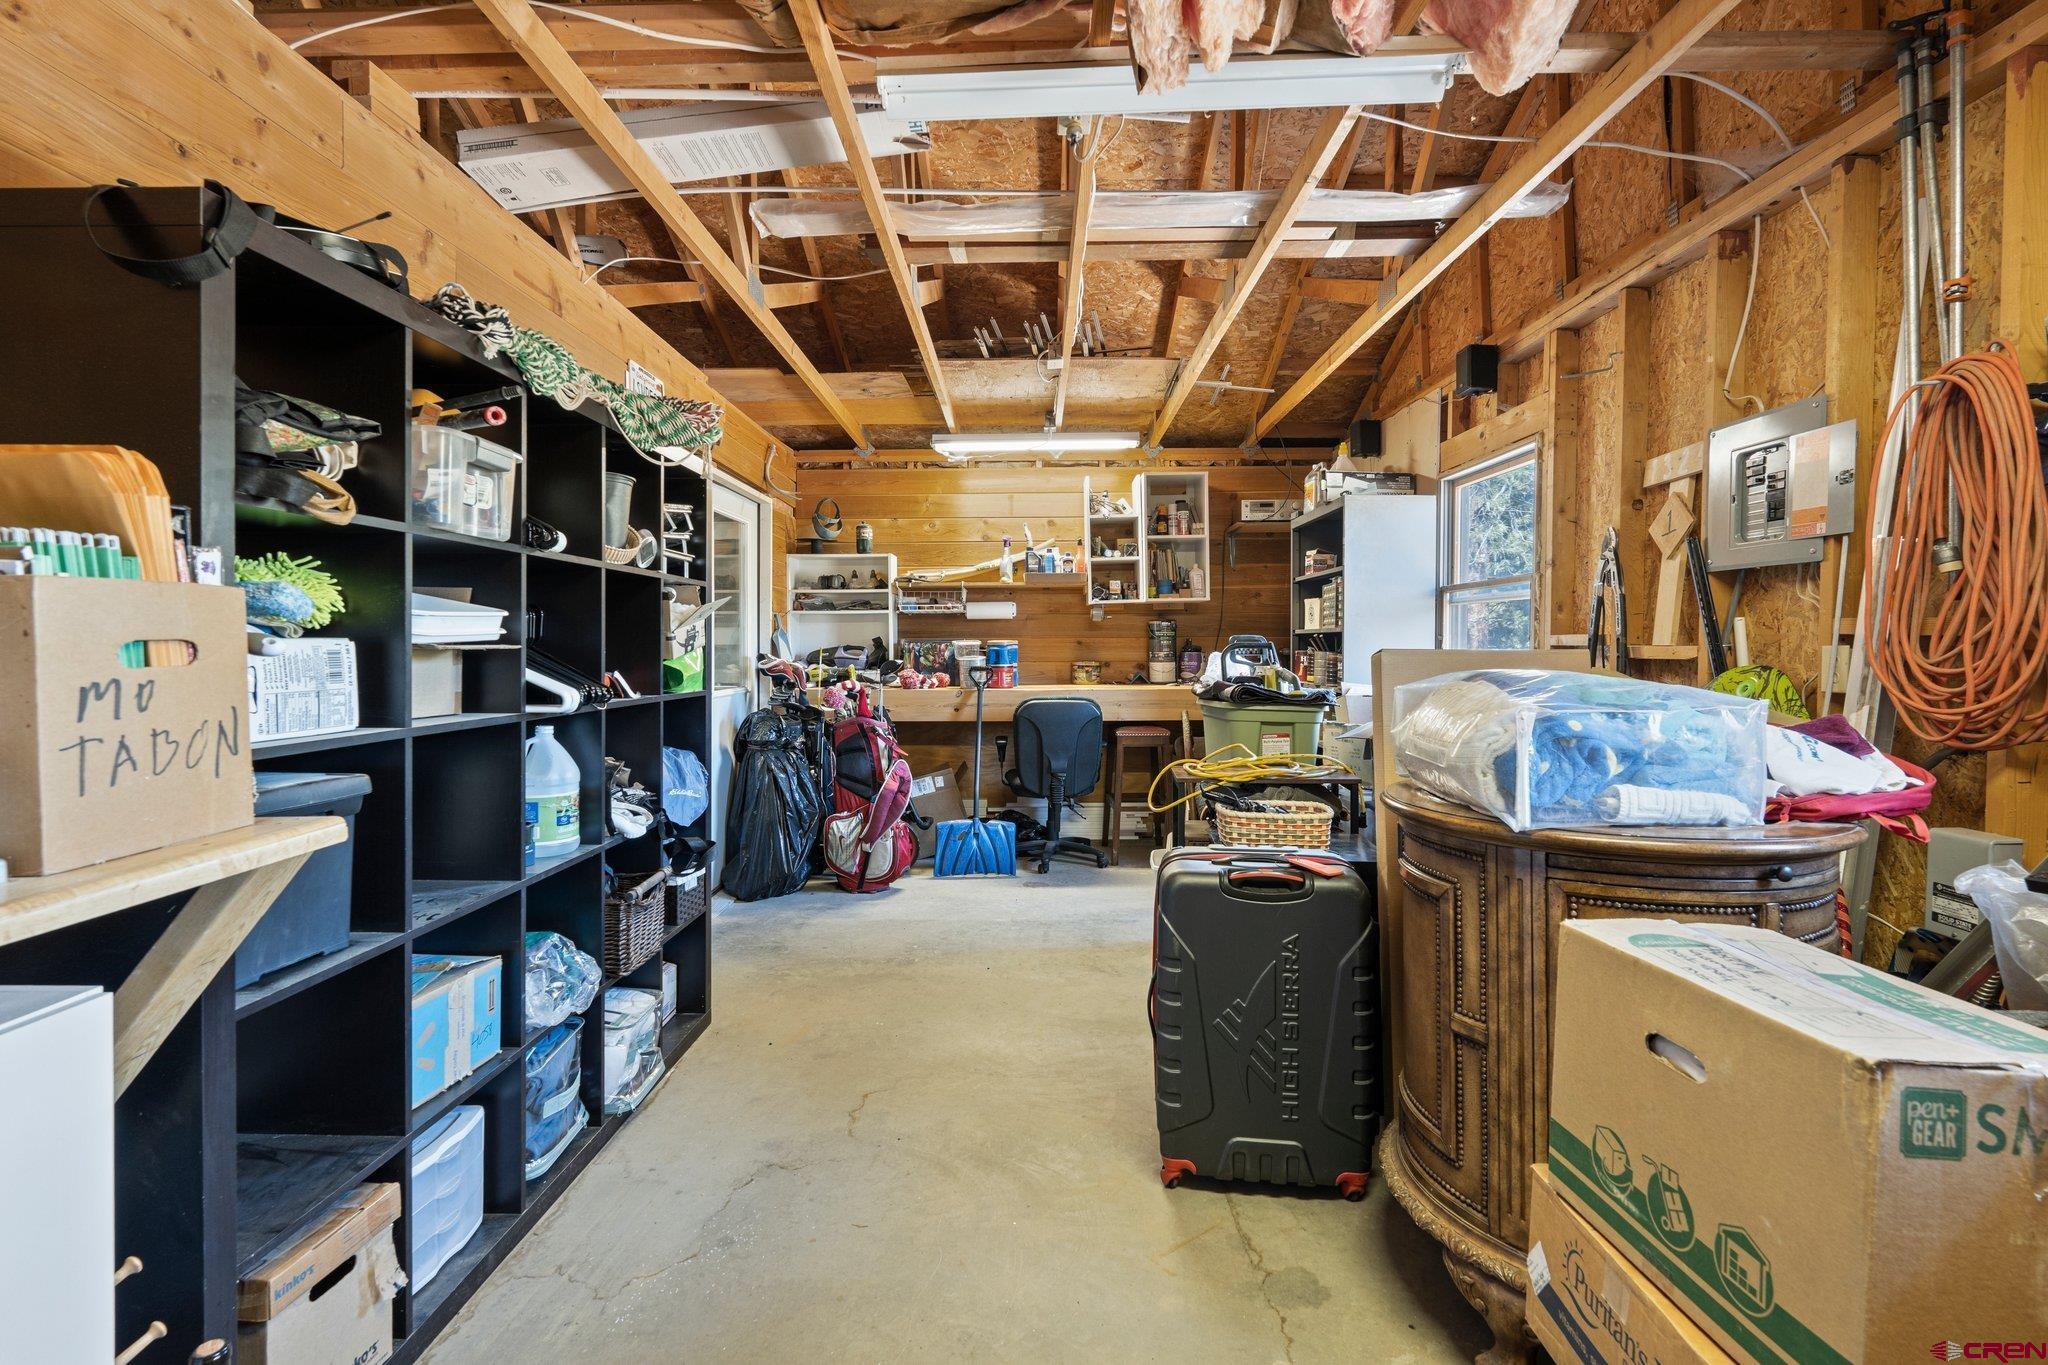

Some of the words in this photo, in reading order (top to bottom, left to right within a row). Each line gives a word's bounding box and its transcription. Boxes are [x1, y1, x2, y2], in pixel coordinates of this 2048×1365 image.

[58, 705, 240, 798] TABON
[1281, 932, 1300, 1040] SIERRA
[1281, 1047, 1300, 1123] HIGH
[1912, 1120, 1957, 1149] GEAR
[273, 1263, 316, 1302] kinko's
[1573, 1261, 1649, 1365] Puritan's
